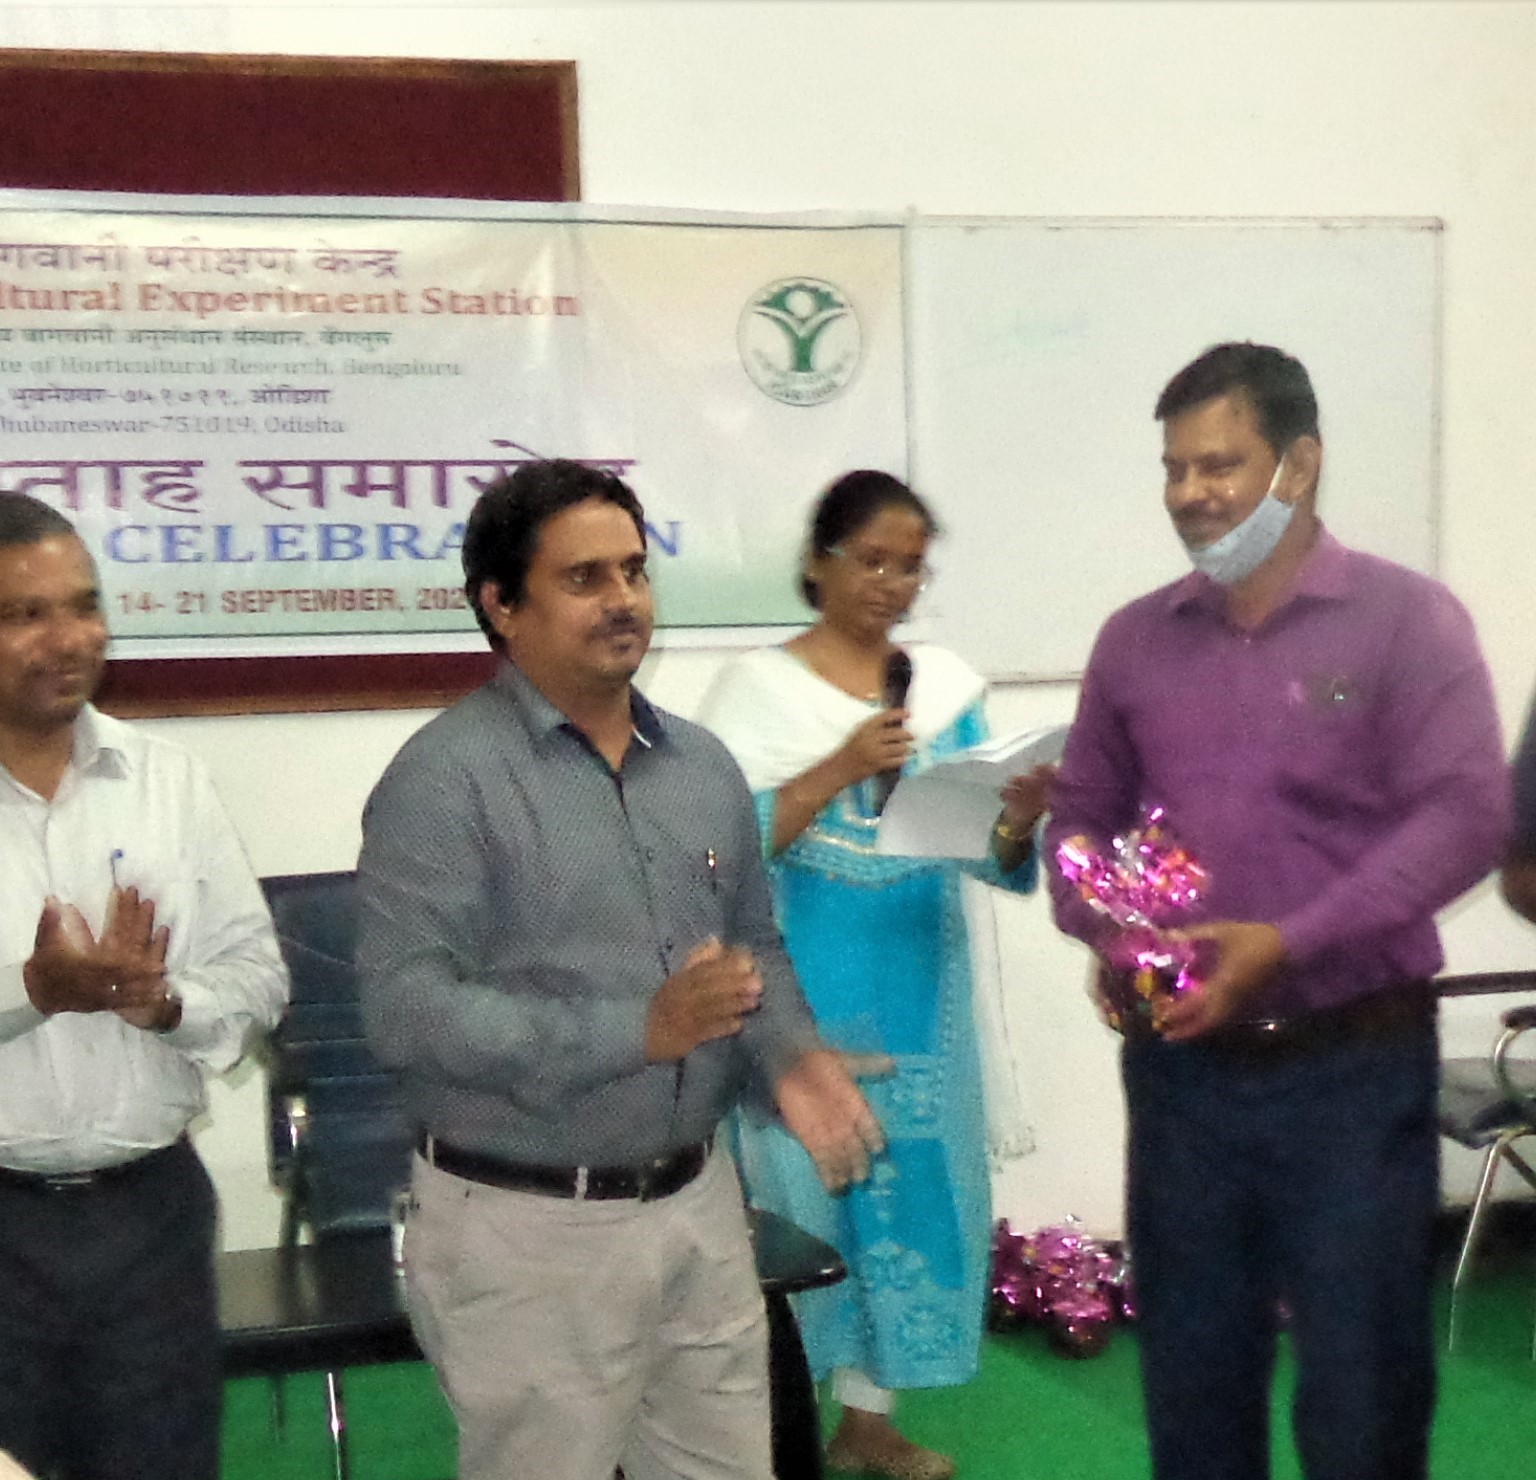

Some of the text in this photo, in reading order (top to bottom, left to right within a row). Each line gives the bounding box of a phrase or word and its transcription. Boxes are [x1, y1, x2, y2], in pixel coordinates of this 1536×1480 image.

[136, 282, 408, 318] Experiment
[419, 287, 581, 317] Station
[30, 356, 58, 374] of
[64, 356, 216, 376] Horticultural
[264, 415, 347, 434] Odisha
[177, 593, 208, 613] 21
[220, 588, 406, 613] SEPTEMBER,
